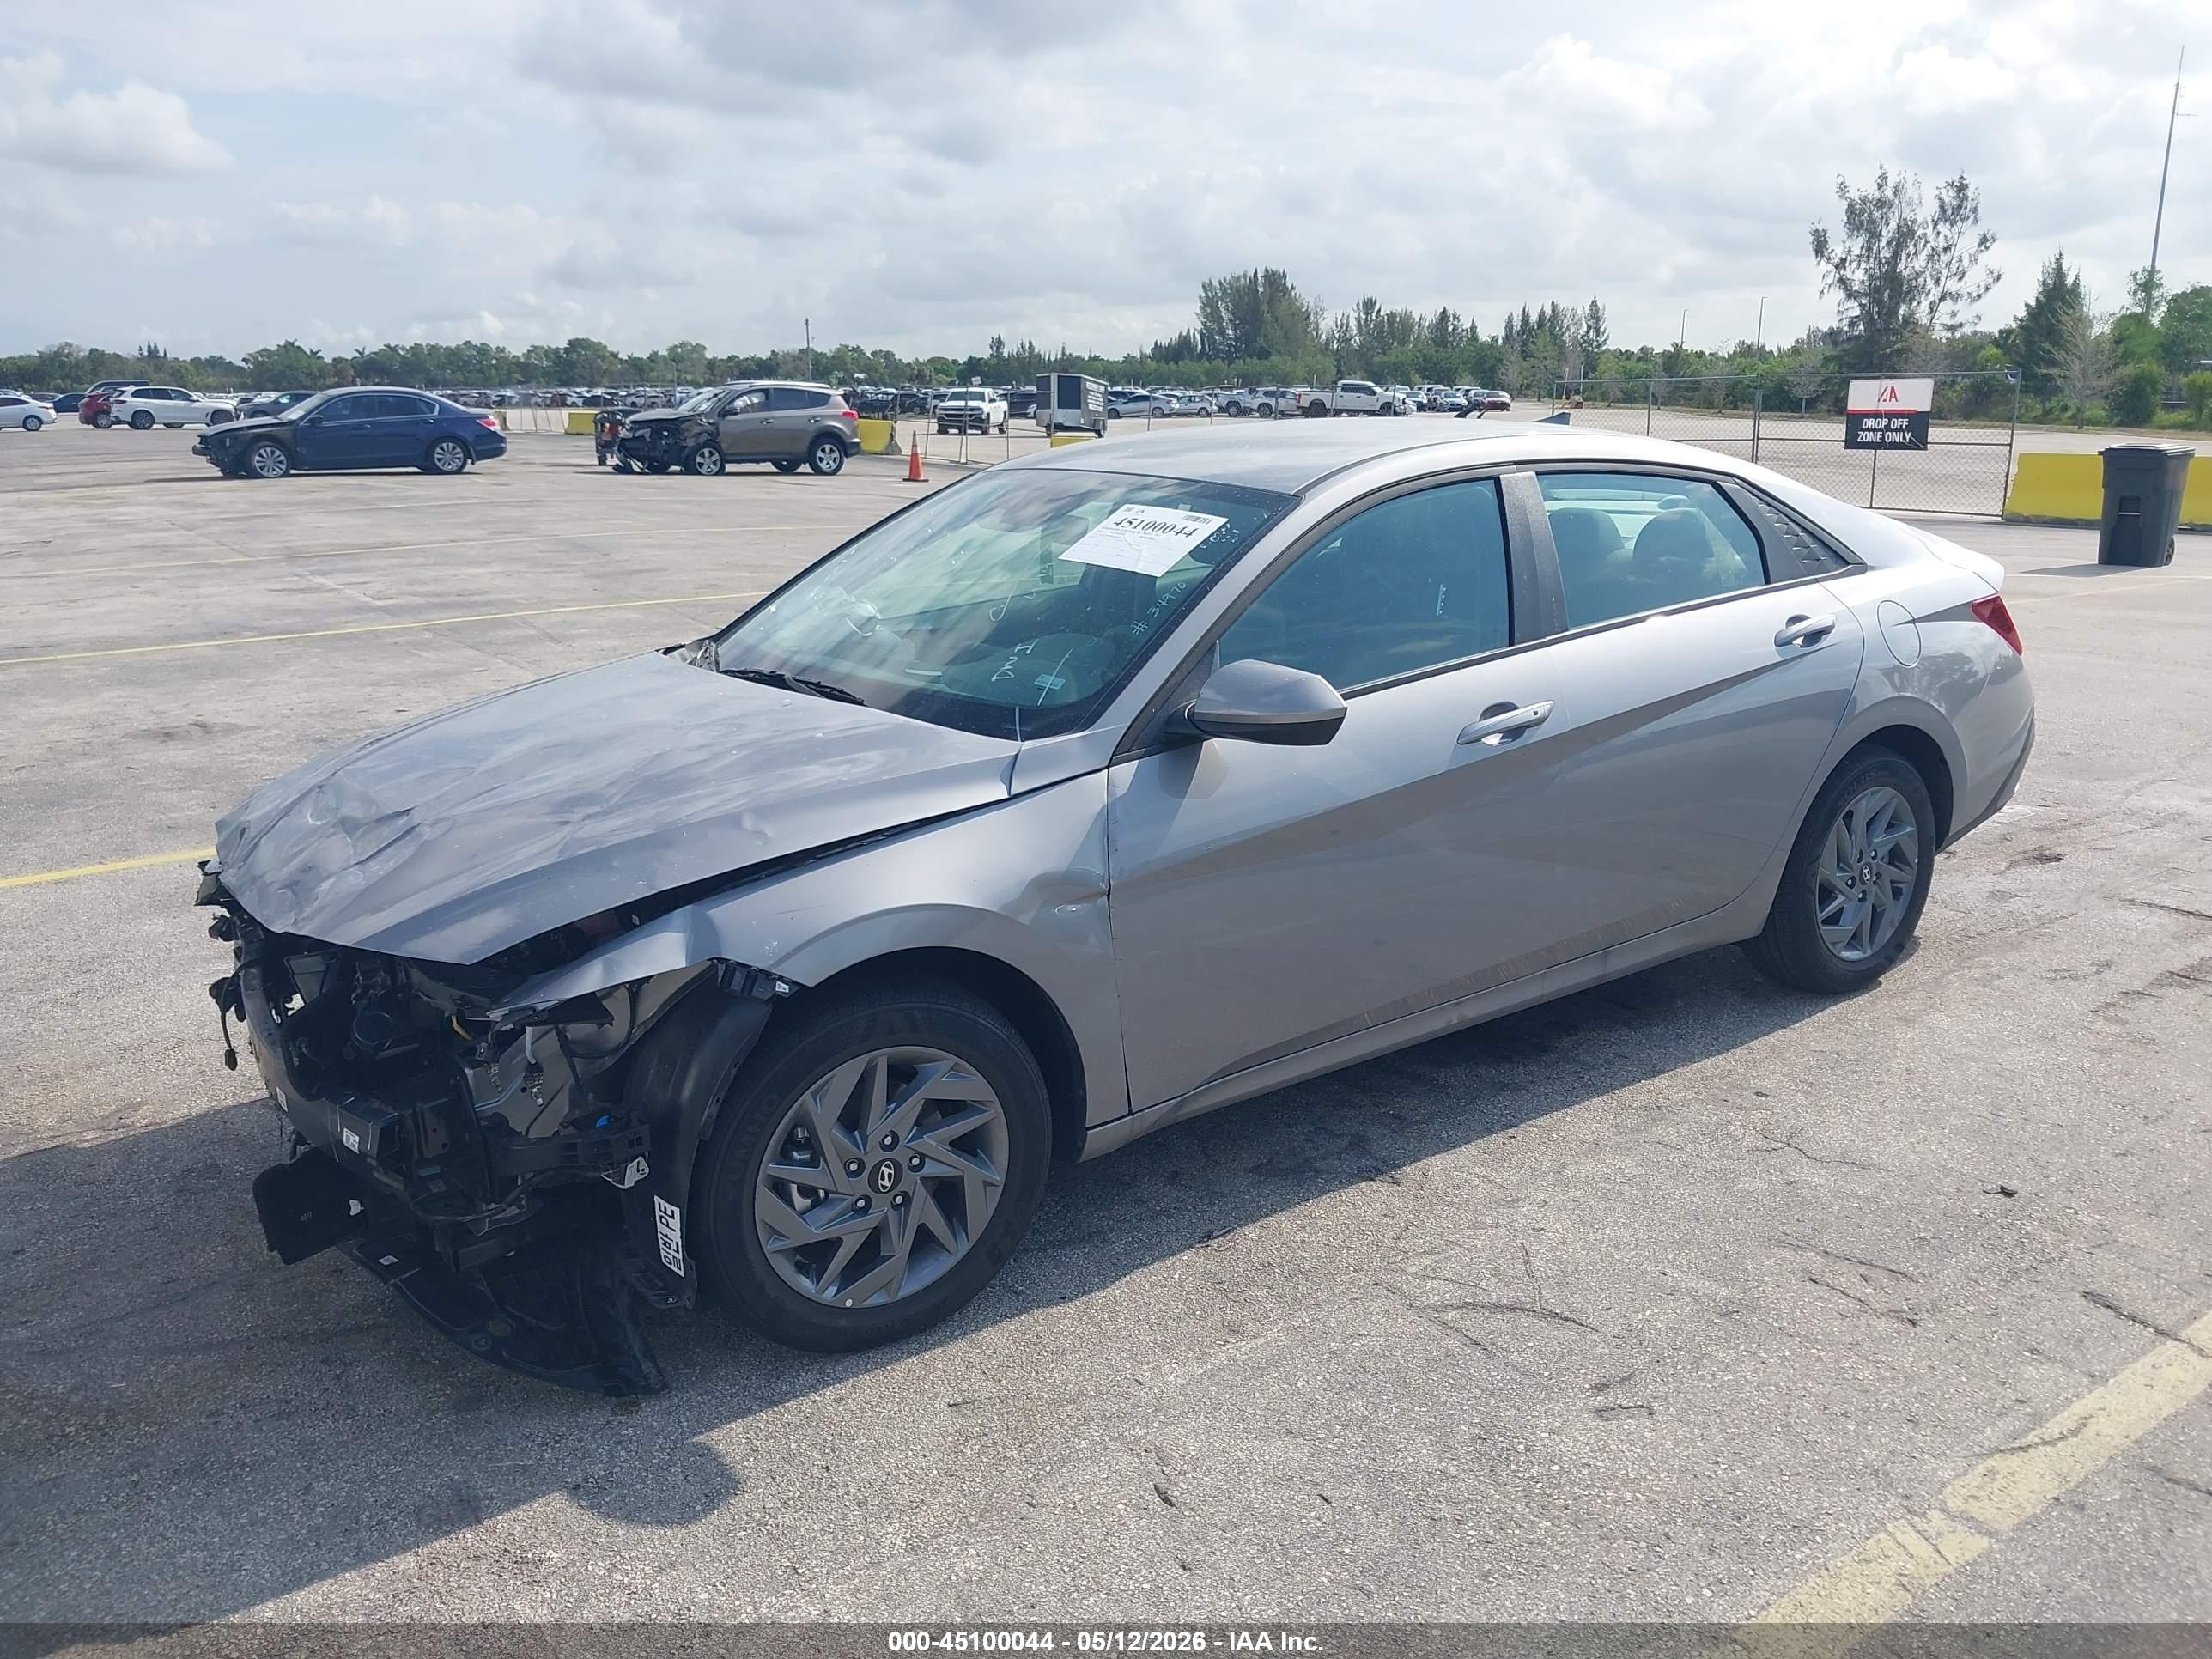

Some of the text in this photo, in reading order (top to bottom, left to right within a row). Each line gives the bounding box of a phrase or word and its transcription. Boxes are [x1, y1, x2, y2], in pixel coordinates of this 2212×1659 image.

[1862, 418, 1909, 429] DROP OFF
[1857, 432, 1911, 443] ZONE ONLY
[1113, 517, 1198, 538] 45100044
[727, 1093, 779, 1202] KUMHO
[658, 1201, 682, 1272] 일반 PE
